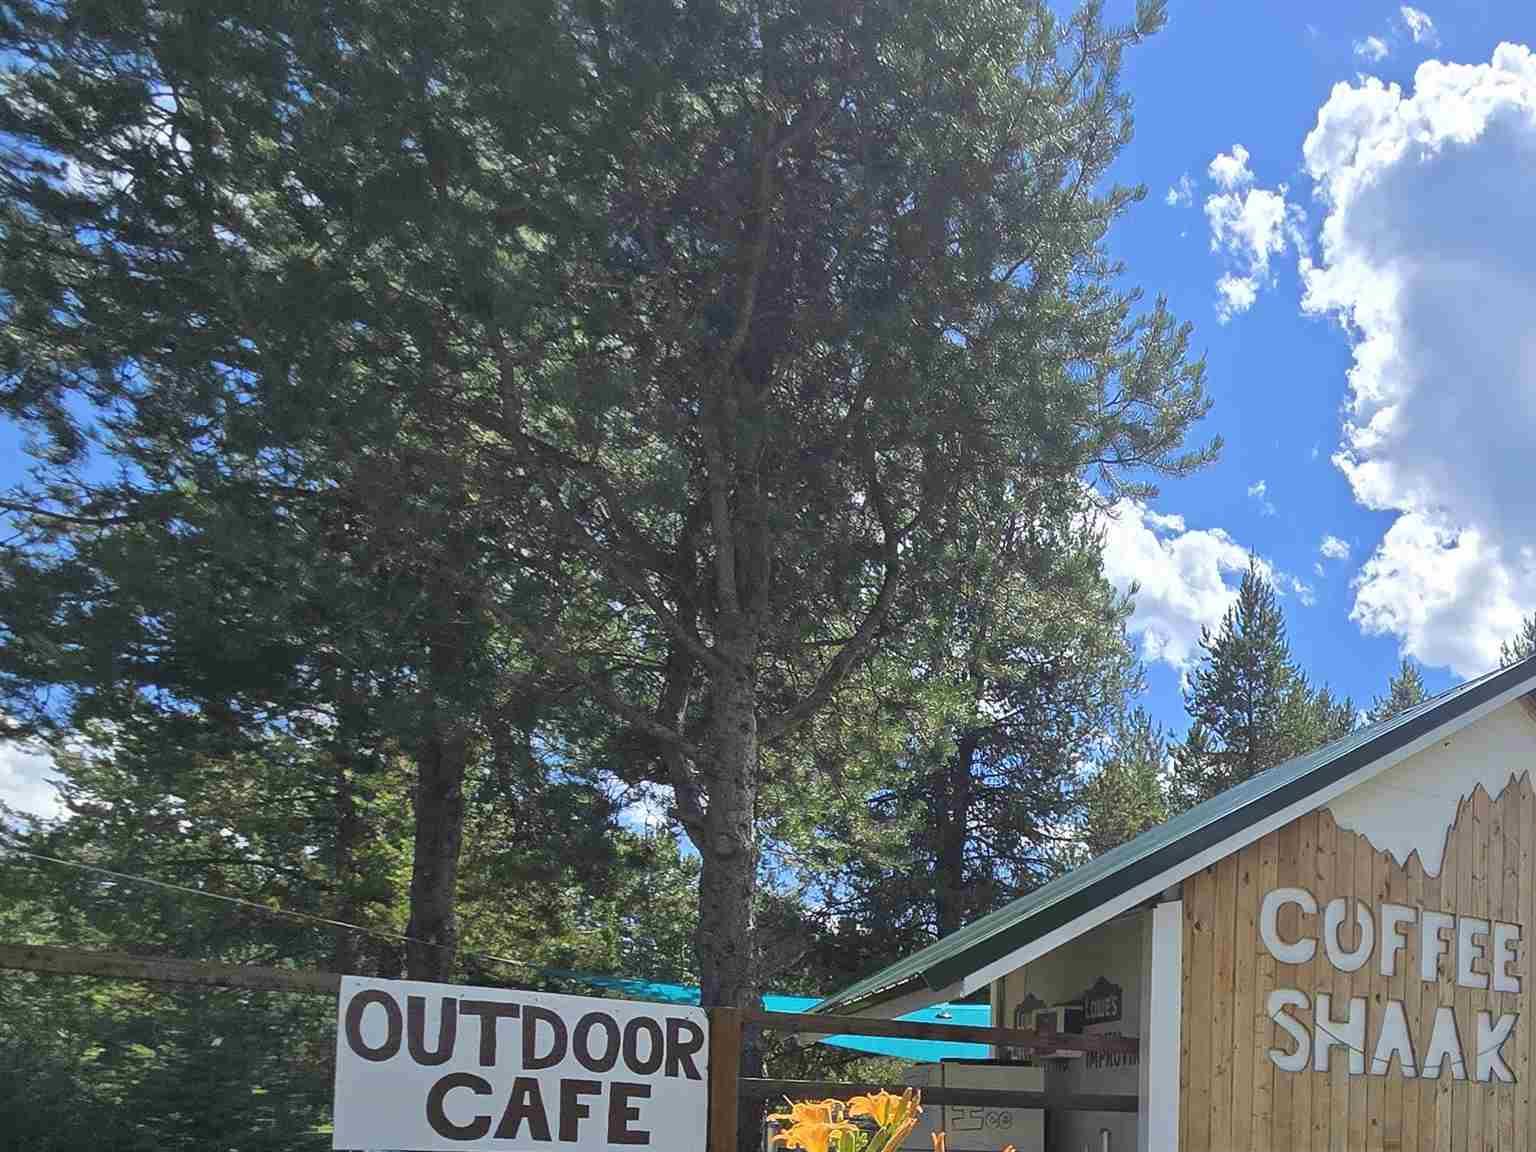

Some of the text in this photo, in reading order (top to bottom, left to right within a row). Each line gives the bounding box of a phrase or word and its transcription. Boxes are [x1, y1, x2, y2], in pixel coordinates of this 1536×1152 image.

[1260, 887, 1522, 993] COFFEE
[345, 989, 704, 1081] OUTDOOR
[1267, 988, 1519, 1083] SHAAK
[426, 1072, 652, 1145] CAFE
